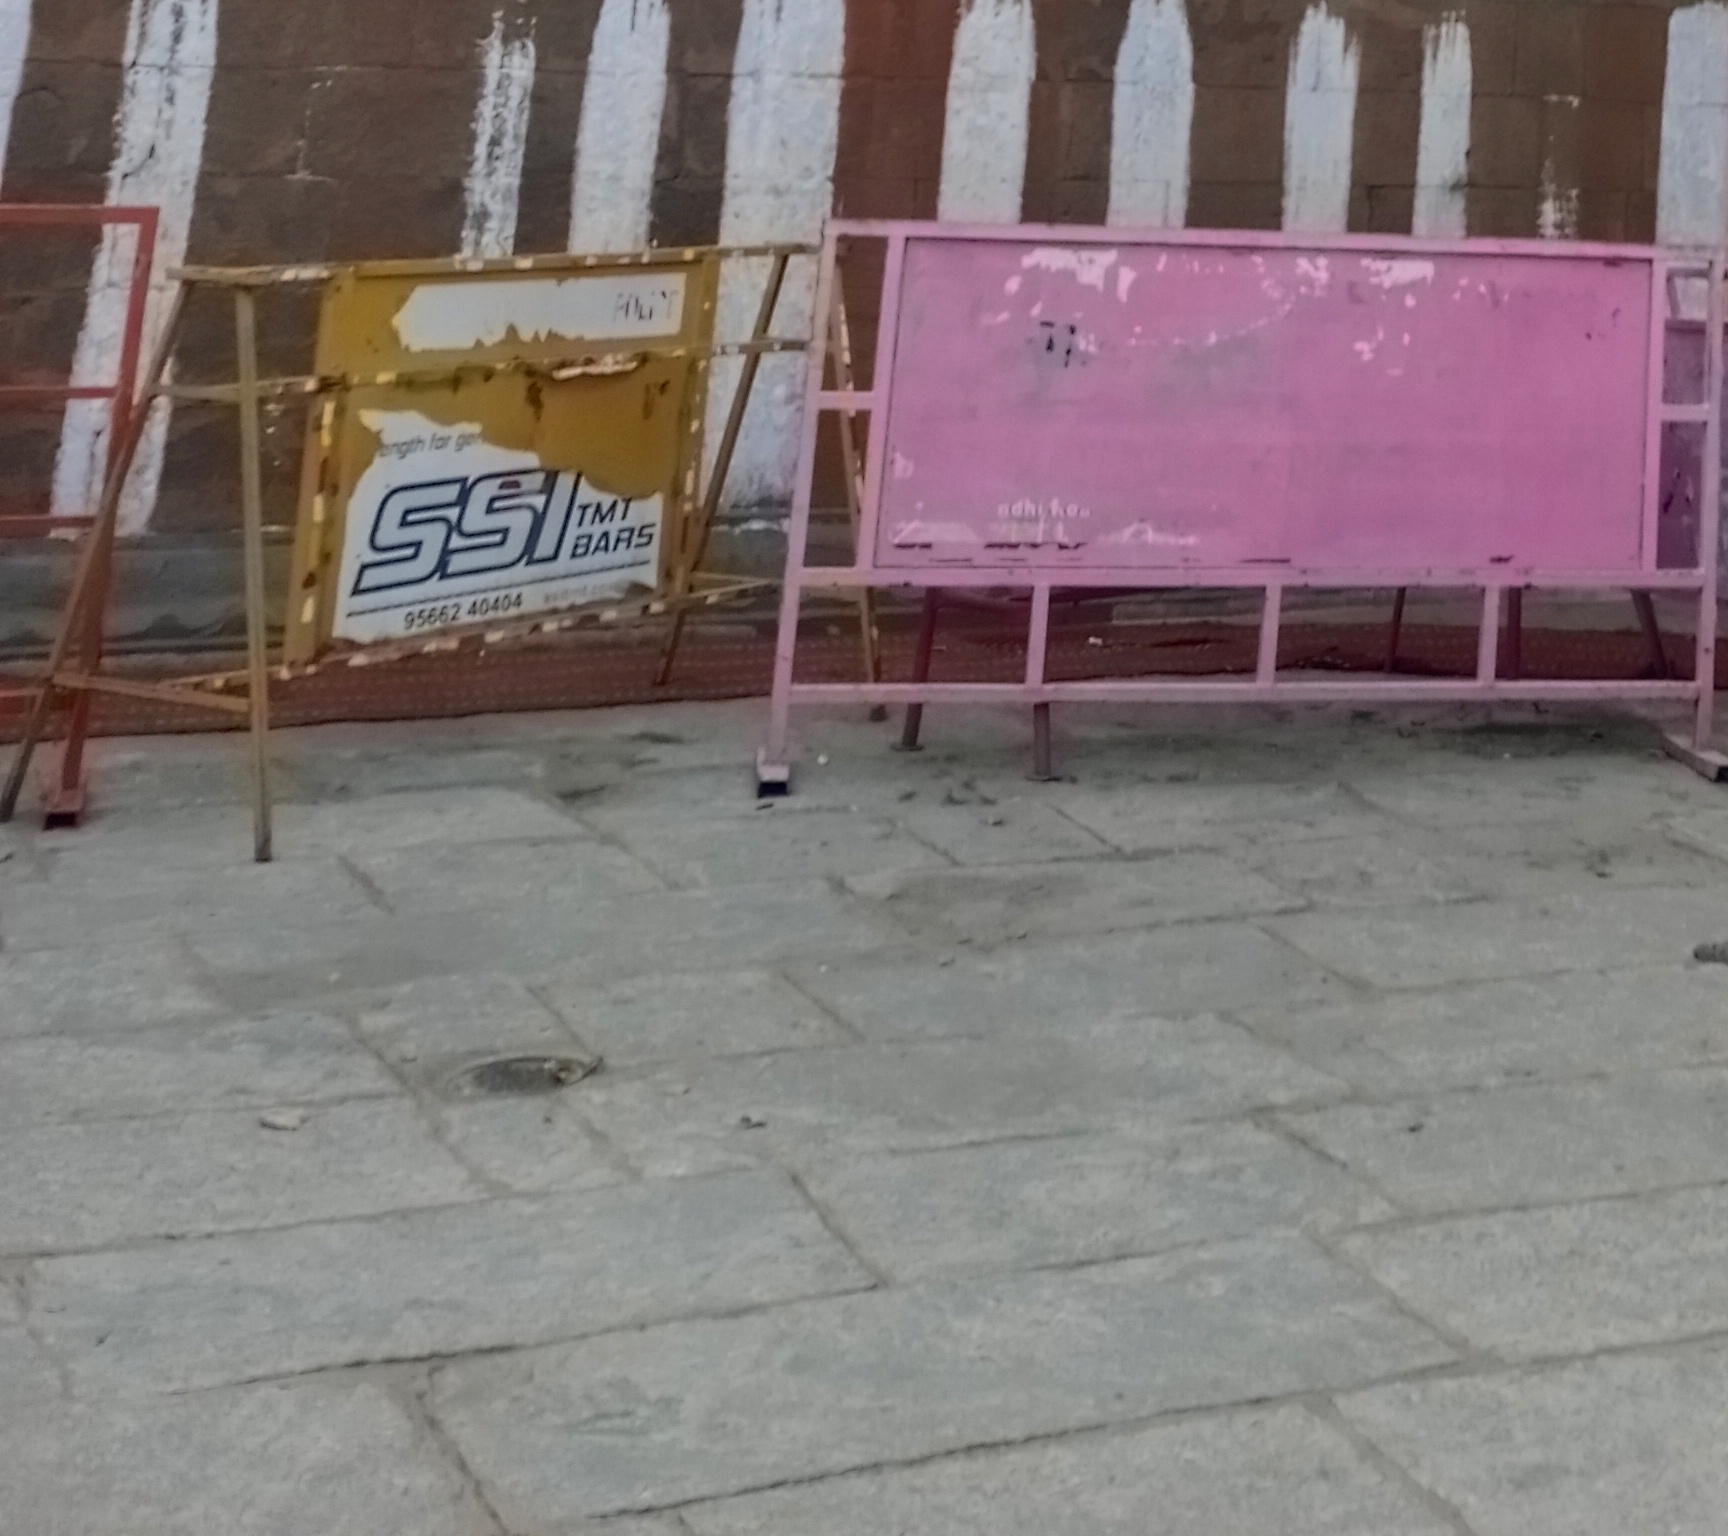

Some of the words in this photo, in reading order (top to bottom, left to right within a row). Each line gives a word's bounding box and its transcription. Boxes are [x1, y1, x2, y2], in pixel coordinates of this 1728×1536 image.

[379, 434, 426, 460] ength
[575, 496, 633, 528] TMT
[350, 466, 584, 597] SSI
[570, 523, 656, 560] BARS
[404, 602, 460, 630] 95662
[467, 592, 523, 617] 40404
